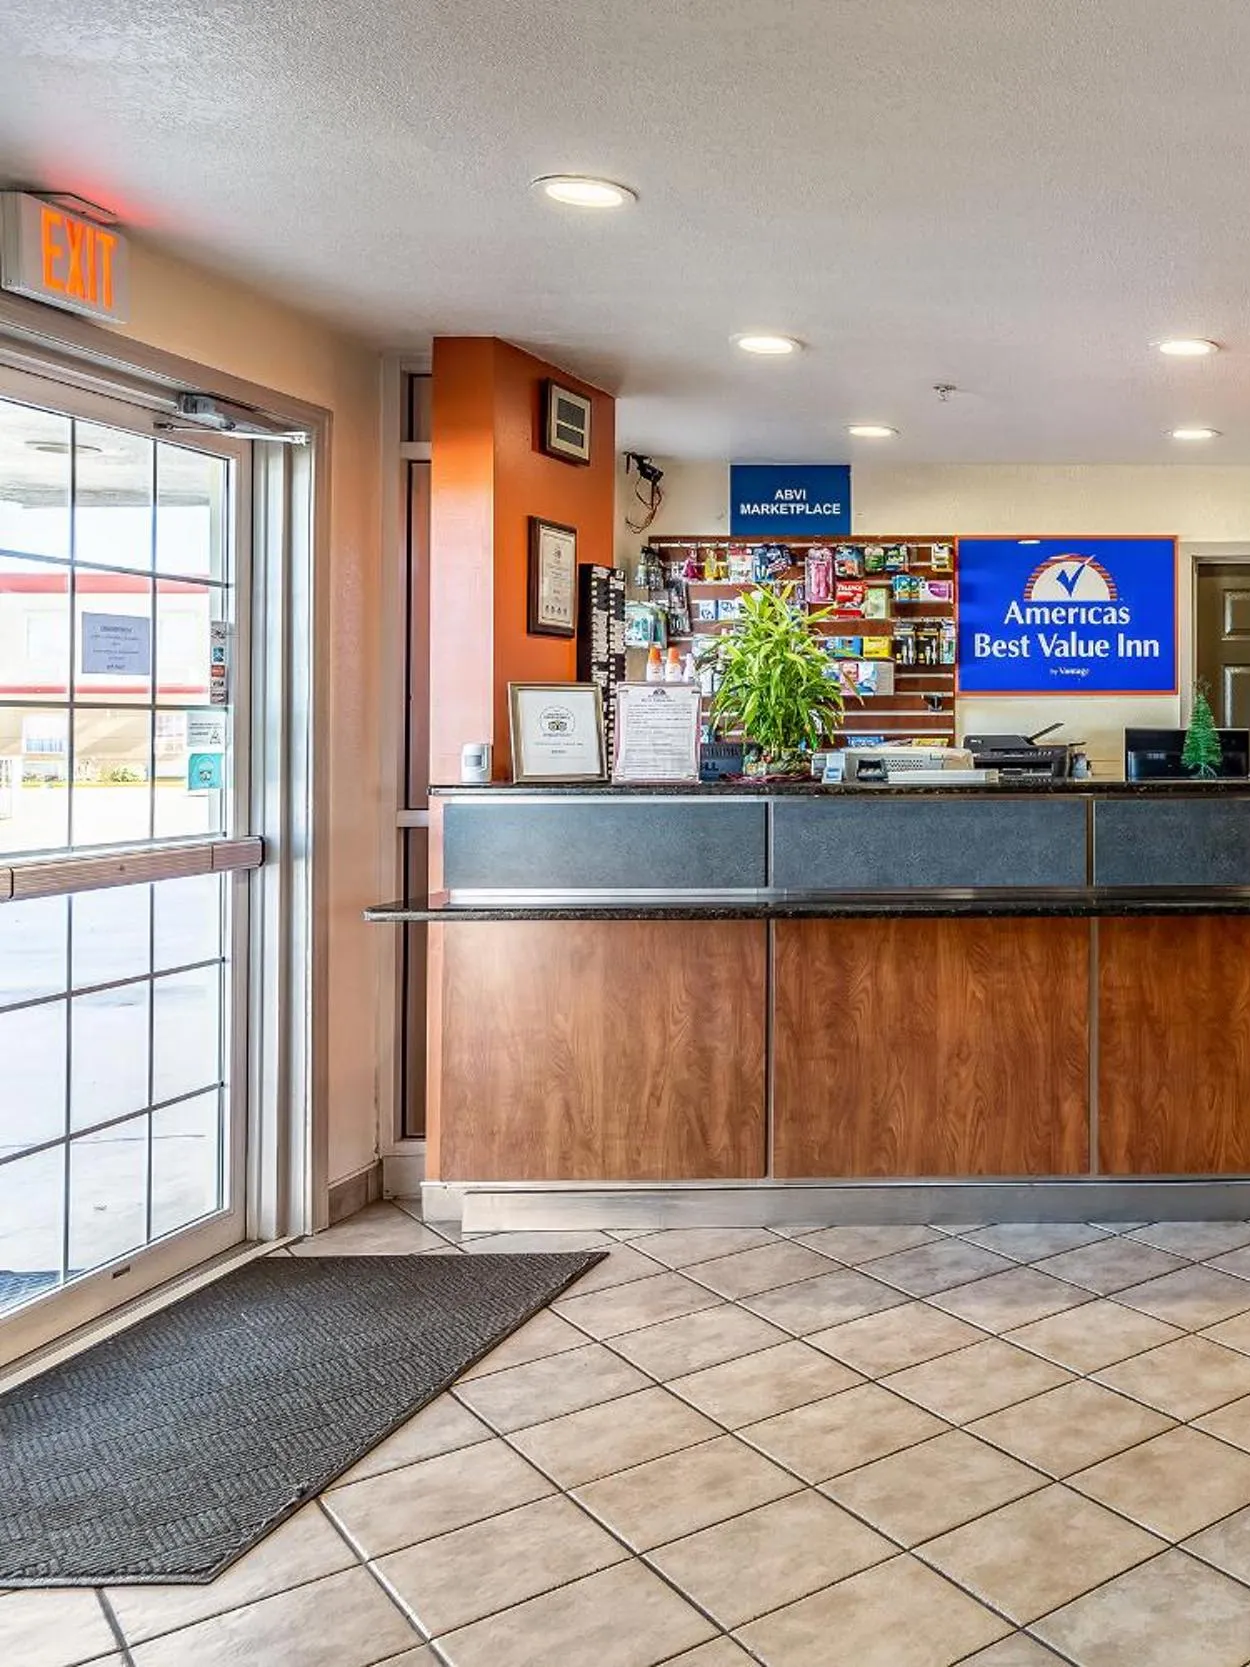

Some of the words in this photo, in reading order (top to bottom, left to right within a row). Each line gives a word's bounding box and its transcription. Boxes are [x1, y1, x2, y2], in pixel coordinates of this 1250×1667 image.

[41, 206, 117, 312] EXIT
[774, 489, 807, 500] ABVI
[740, 503, 841, 515] MARKETPLACE
[1004, 600, 1131, 625] Americas
[974, 633, 1030, 658] Best
[1038, 632, 1109, 658] Value
[1117, 633, 1160, 658] Inn
